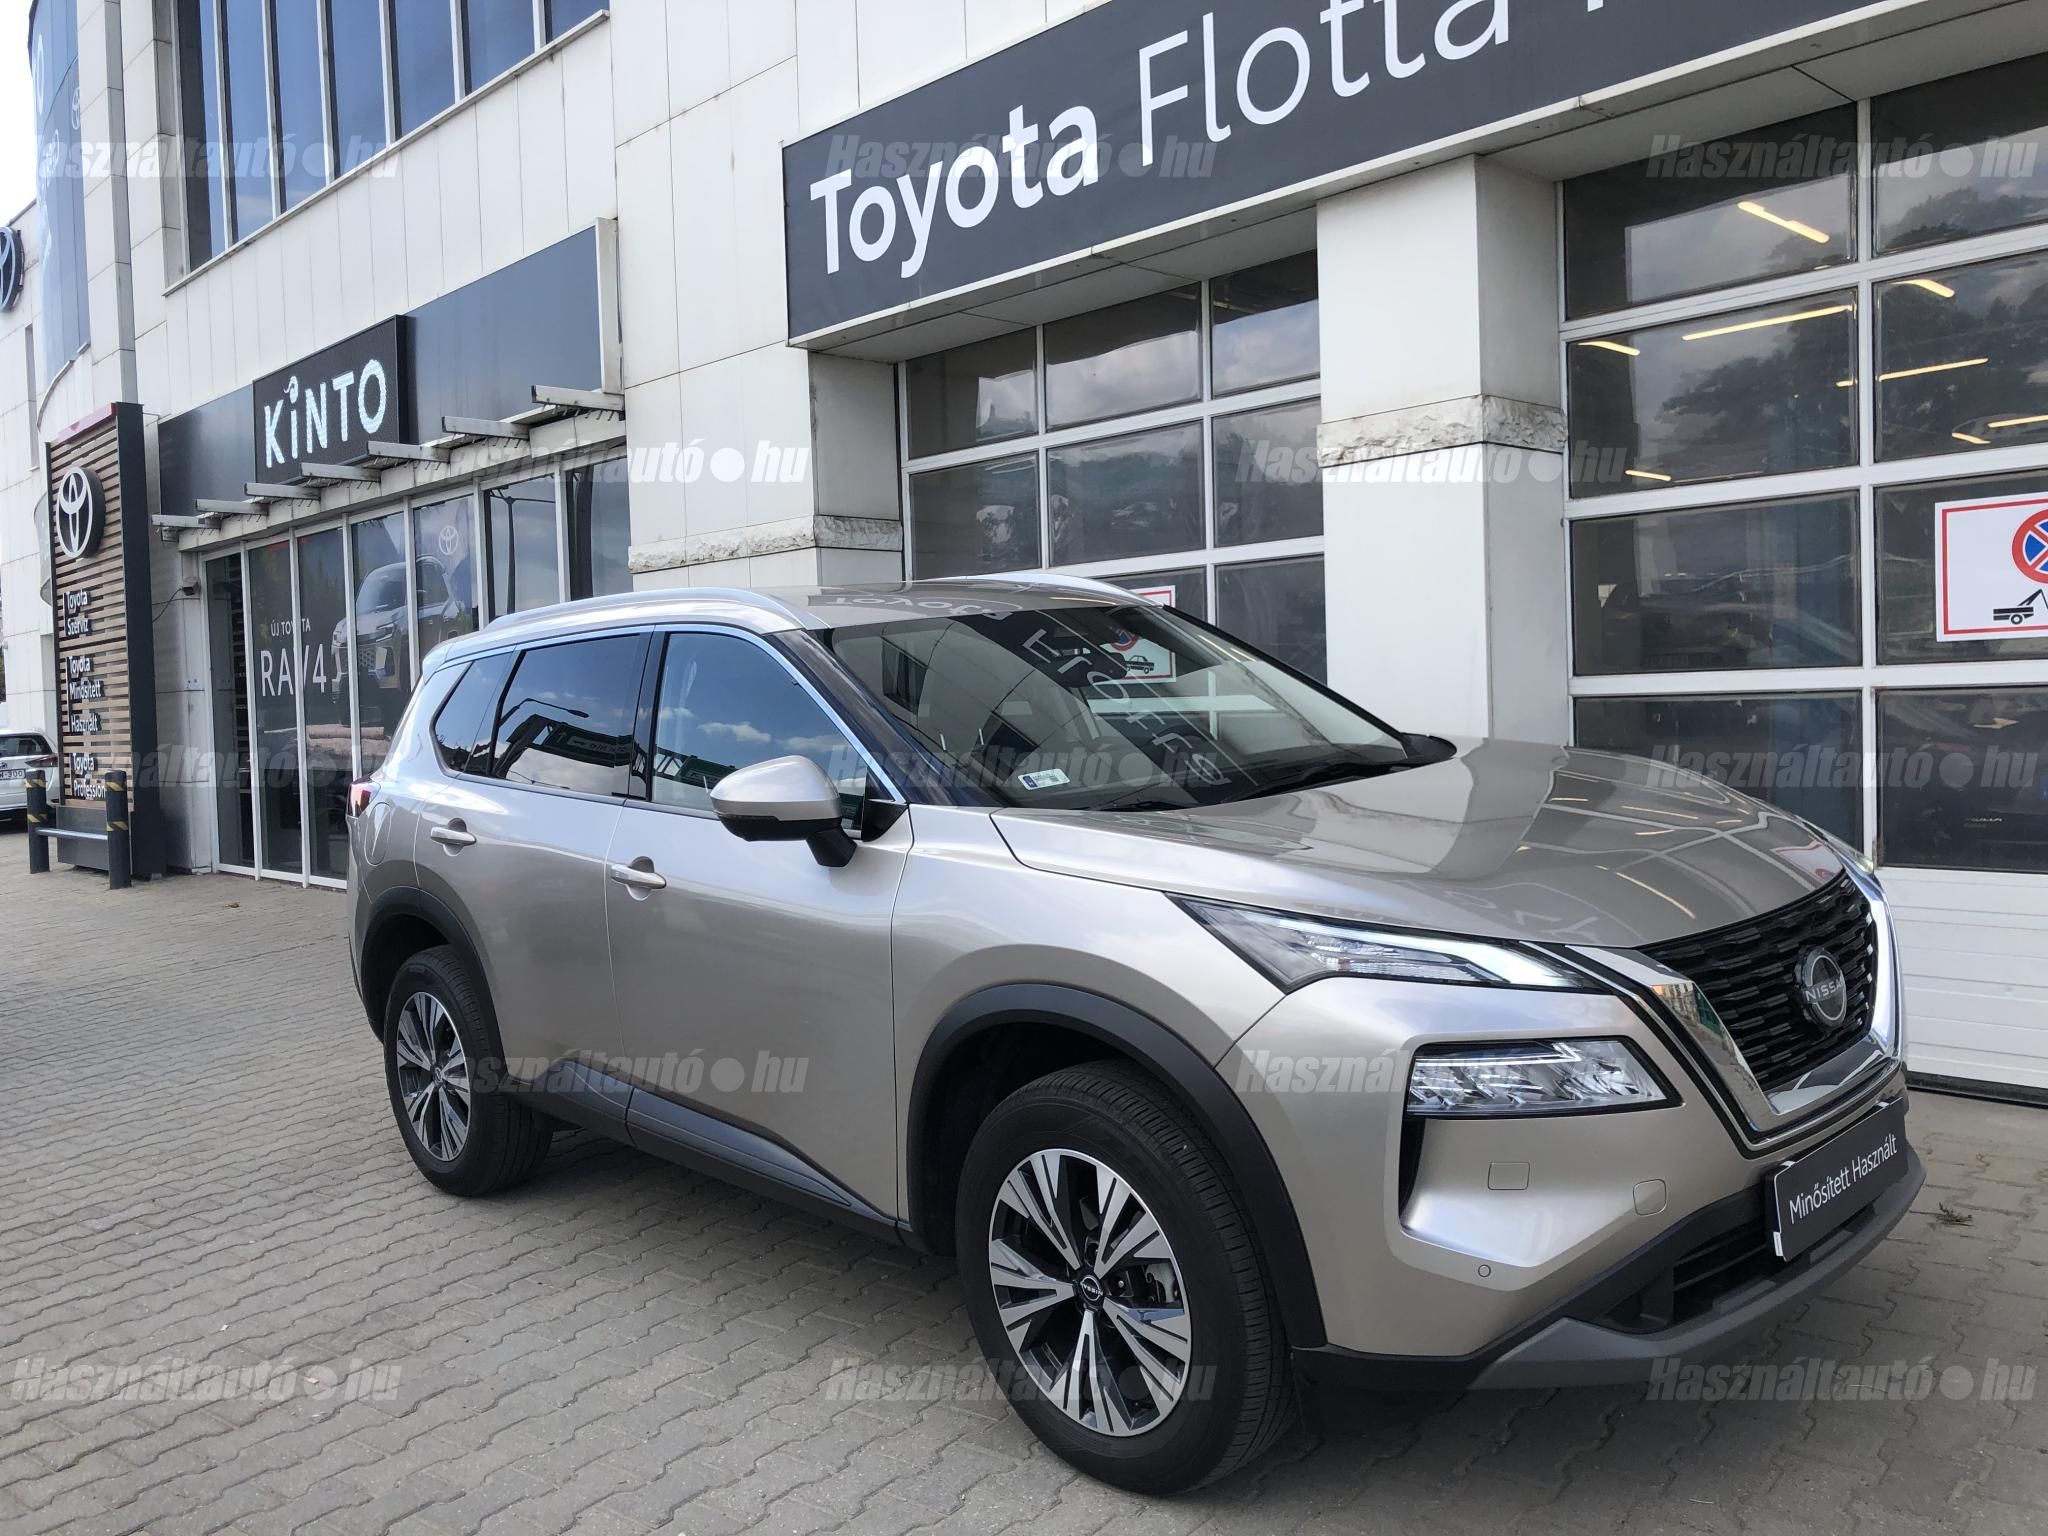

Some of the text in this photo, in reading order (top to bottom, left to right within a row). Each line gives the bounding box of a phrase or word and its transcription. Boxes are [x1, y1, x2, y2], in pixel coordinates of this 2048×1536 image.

[810, 0, 1510, 278] Toyota Flotta
[66, 589, 88, 613] Toyota
[67, 618, 89, 636] Szerviz
[270, 617, 311, 637] ÚJ TOTA
[69, 655, 91, 677] Toyota
[260, 643, 327, 697] RAV4
[71, 711, 98, 733] Használt
[73, 752, 95, 776] Toyota
[74, 778, 106, 799] Profession
[1805, 978, 1843, 1001] NISSA
[1789, 1133, 1897, 1225] Minősített Használt
